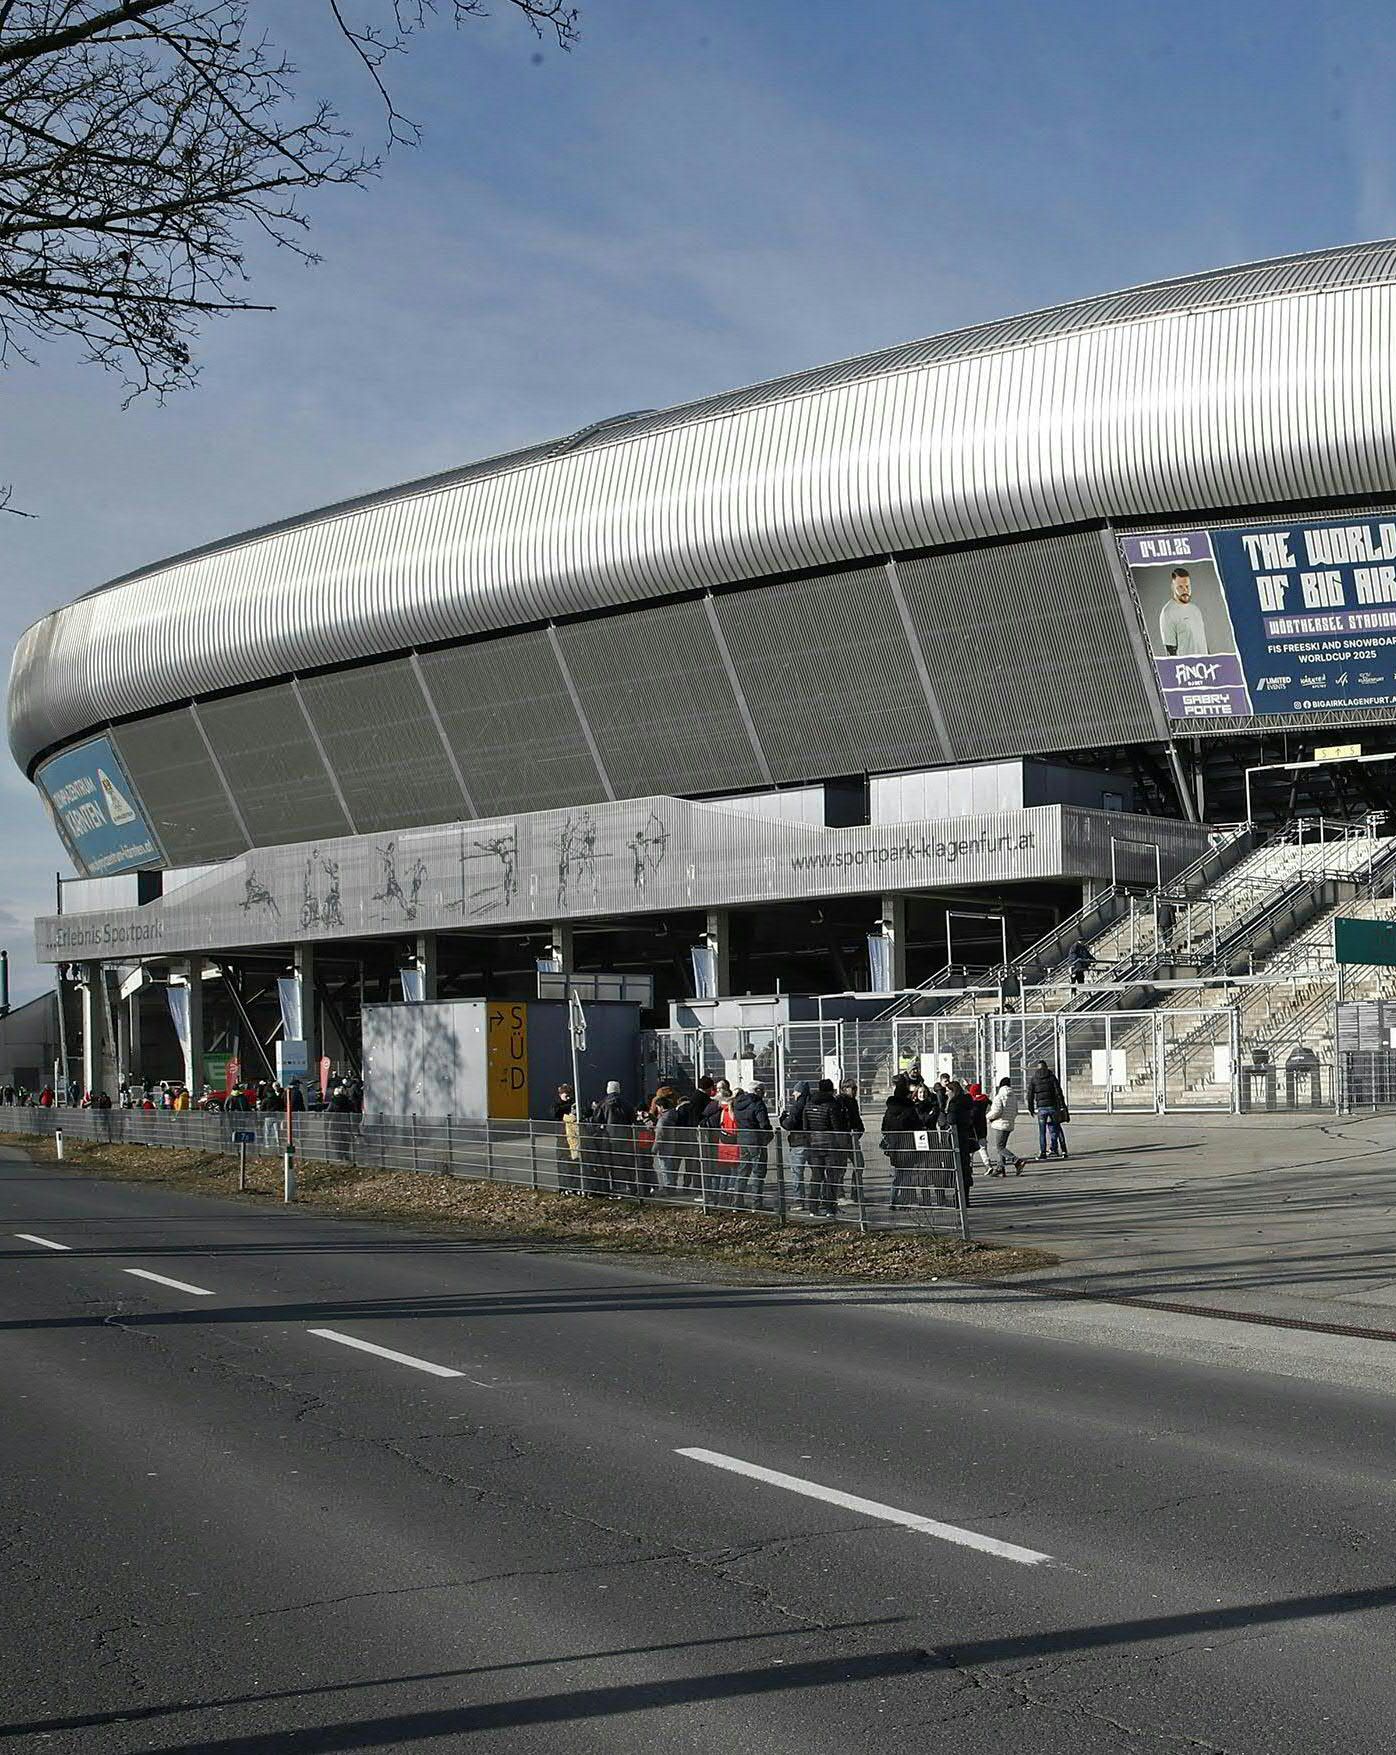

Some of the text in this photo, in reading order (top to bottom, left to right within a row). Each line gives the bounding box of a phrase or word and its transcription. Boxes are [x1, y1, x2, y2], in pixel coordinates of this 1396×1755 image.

[1140, 538, 1191, 558] 04.01.25
[1242, 532, 1297, 571] THE
[1256, 574, 1289, 612] OF
[1300, 570, 1346, 609] BIG
[1268, 644, 1282, 653] FIS
[1283, 642, 1320, 653] FREESKI
[1321, 641, 1341, 650] AND
[1298, 650, 1377, 663] WORLDCUP 2025
[1265, 676, 1292, 684] LIMITED
[1182, 693, 1230, 705] GABRY
[1184, 705, 1232, 715] PONTE
[791, 831, 1036, 875] www.sportpark-klagenfurt.at
[103, 919, 163, 948] Sportpark
[511, 1006, 526, 1090] SÜD
